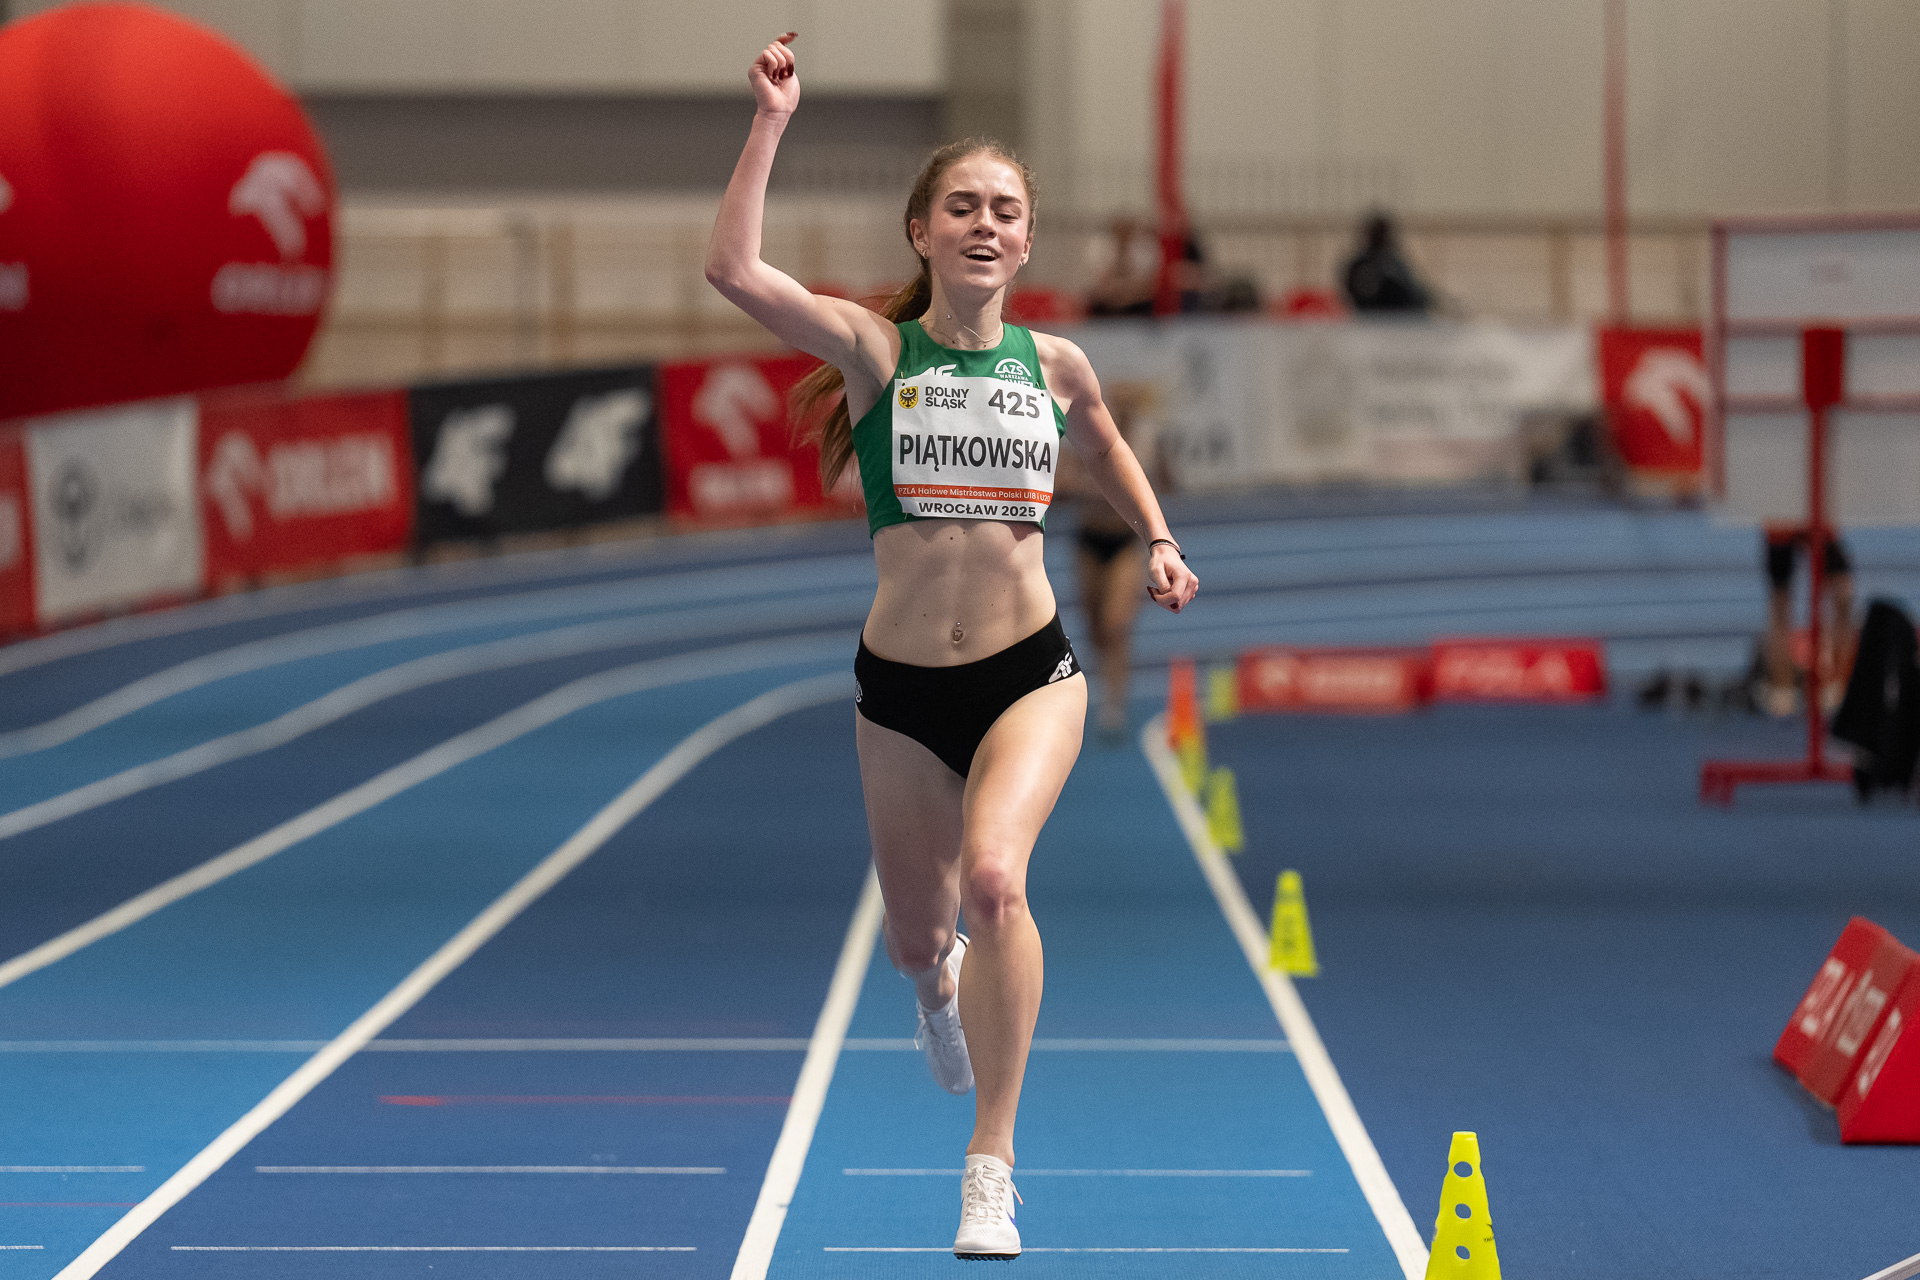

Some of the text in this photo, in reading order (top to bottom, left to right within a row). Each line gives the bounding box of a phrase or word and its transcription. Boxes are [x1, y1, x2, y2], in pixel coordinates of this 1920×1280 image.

[1002, 364, 1024, 376] AZS
[925, 386, 970, 399] DOLNY
[925, 394, 967, 410] ŚLĄSK
[988, 388, 1040, 419] 425
[900, 434, 1052, 473] PIĄTKOWSKA
[898, 487, 916, 495] PZLA
[918, 487, 948, 495] Halowe
[949, 488, 997, 498] Mistrzostwa
[998, 490, 1022, 499] Polski
[1023, 491, 1036, 500] U18
[918, 502, 1037, 517] WROCŁAW 2025
